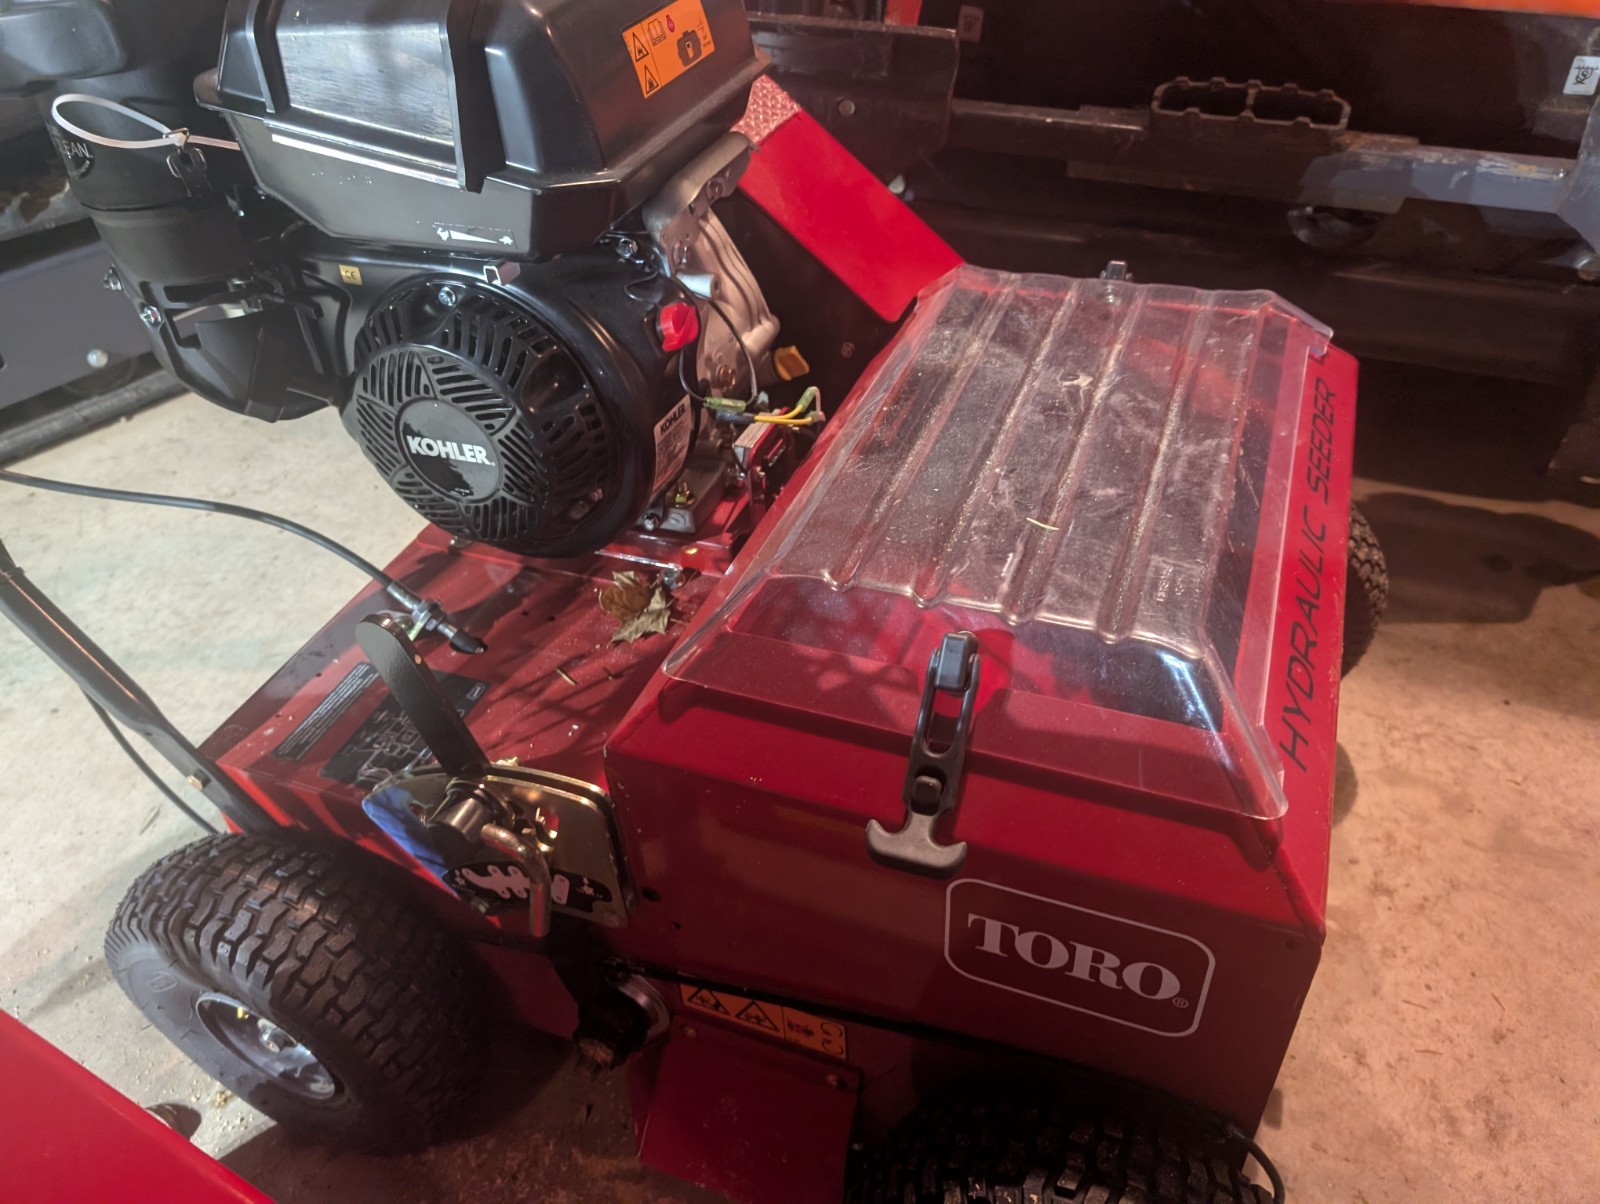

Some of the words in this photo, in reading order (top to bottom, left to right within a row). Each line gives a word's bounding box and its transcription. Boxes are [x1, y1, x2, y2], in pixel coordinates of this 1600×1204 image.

[660, 403, 686, 436] KOHLER
[406, 435, 492, 466] KOHLER
[1279, 504, 1326, 773] HYDRAULIC
[1307, 377, 1335, 504] SEEDER
[967, 912, 1181, 1000] TORO
